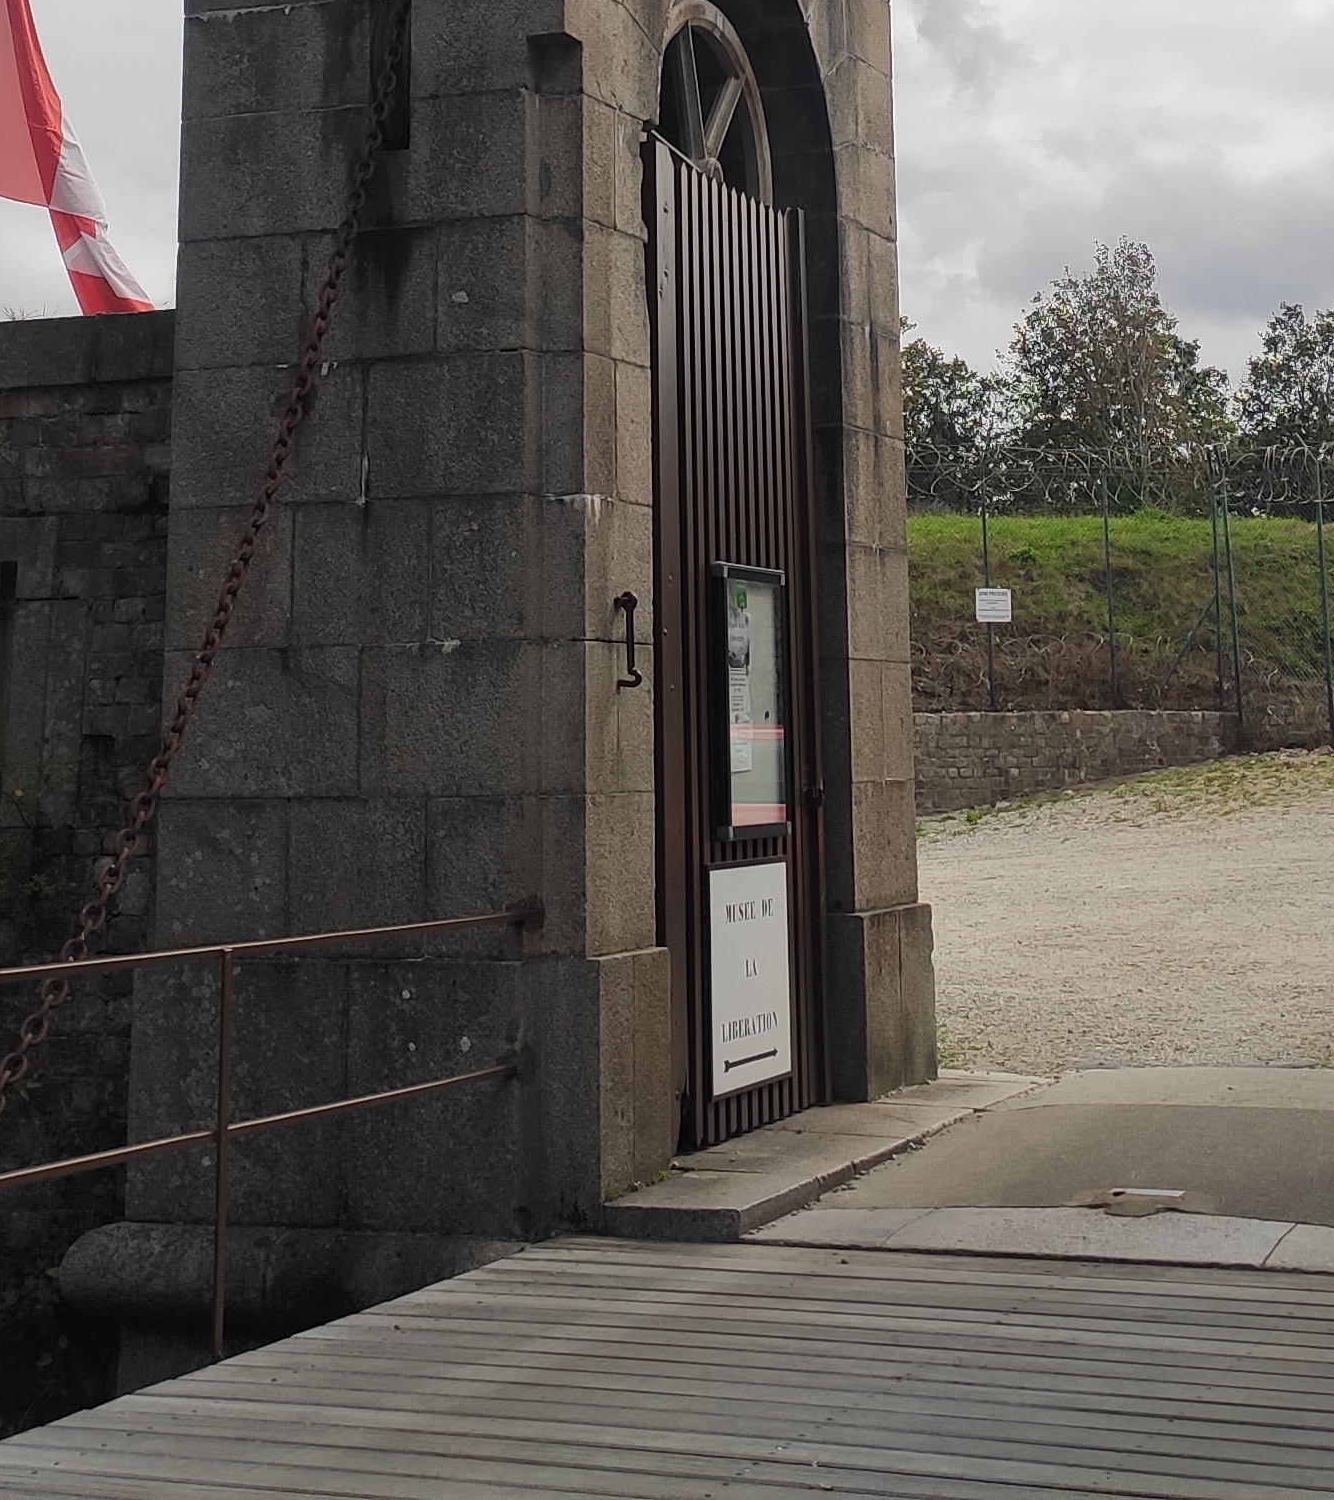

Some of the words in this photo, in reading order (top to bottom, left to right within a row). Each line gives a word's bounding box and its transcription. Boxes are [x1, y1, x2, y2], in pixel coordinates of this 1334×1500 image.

[725, 900, 756, 924] MUSEE
[761, 898, 774, 918] DE
[745, 958, 758, 978] LA
[721, 1011, 778, 1043] LIBERATION
